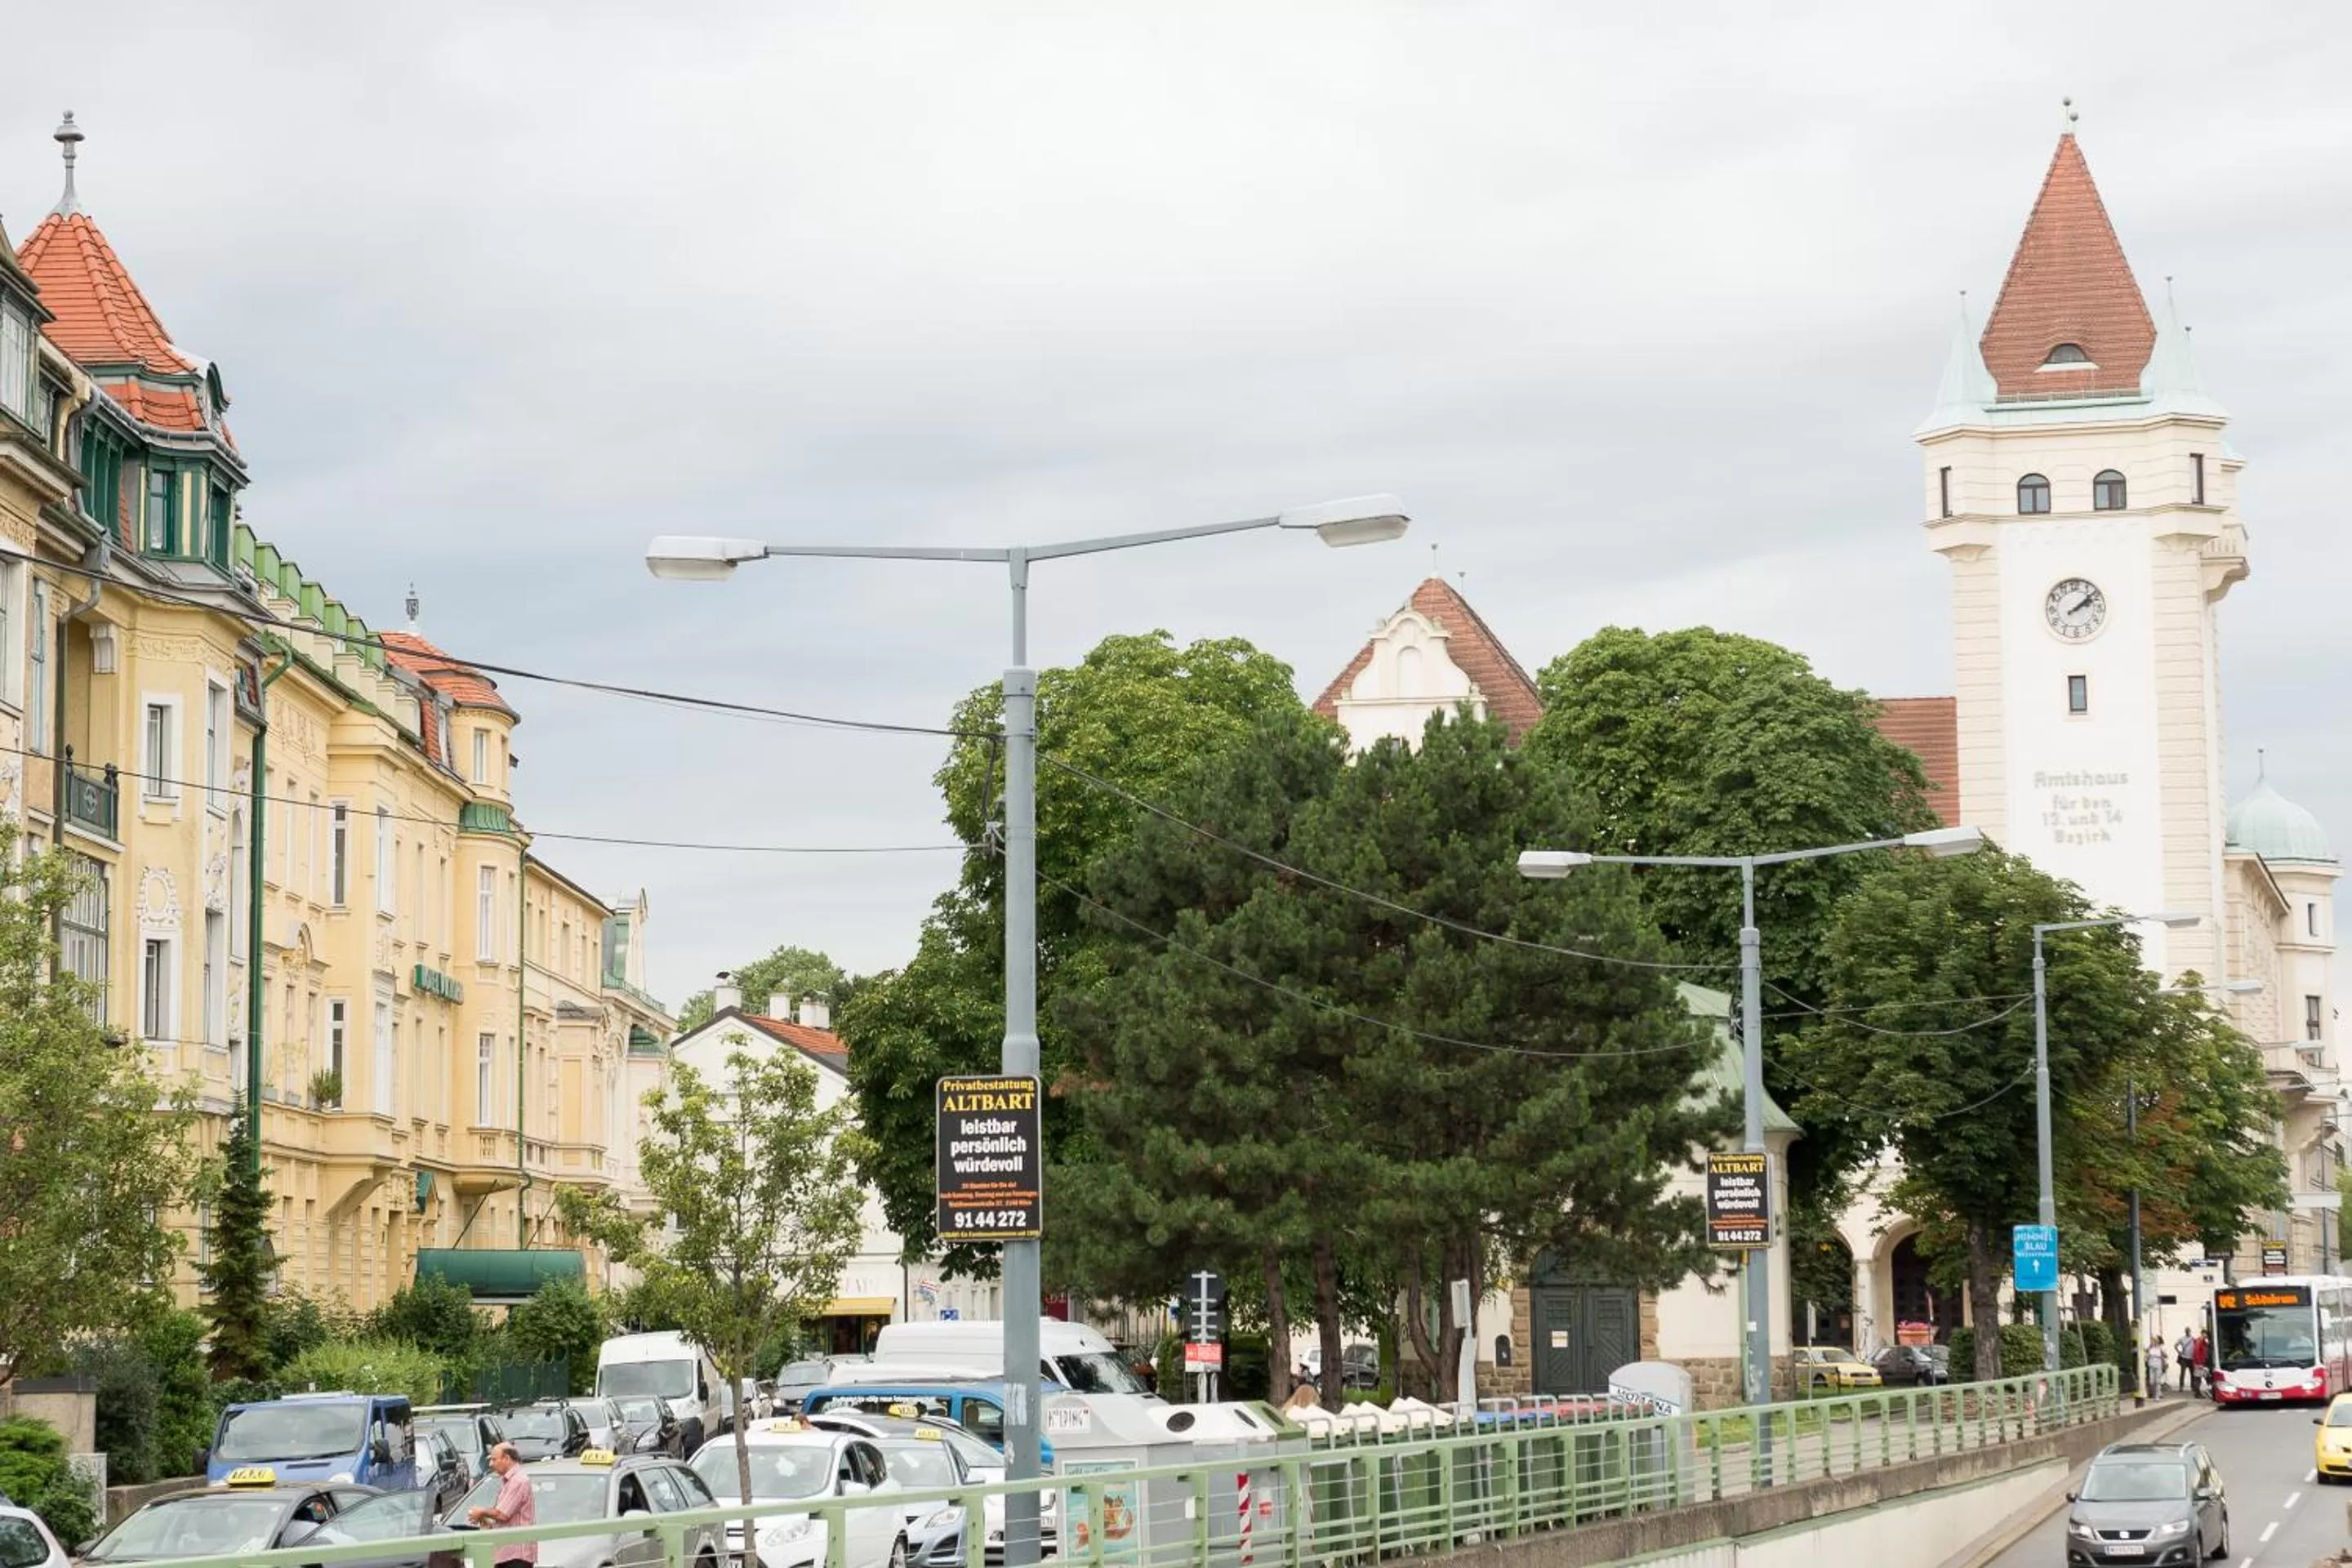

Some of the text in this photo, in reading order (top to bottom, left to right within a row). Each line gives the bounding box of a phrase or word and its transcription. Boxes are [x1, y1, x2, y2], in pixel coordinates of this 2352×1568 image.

[942, 1080, 1035, 1092] Privatbestattung
[942, 1093, 1035, 1111] ALTBART
[960, 1118, 1017, 1135] leistbar
[951, 1136, 1027, 1156] persönlich
[954, 1156, 1023, 1174] würdevoll
[1710, 1162, 1766, 1174] ALTBART
[2025, 1242, 2047, 1250] BLAU
